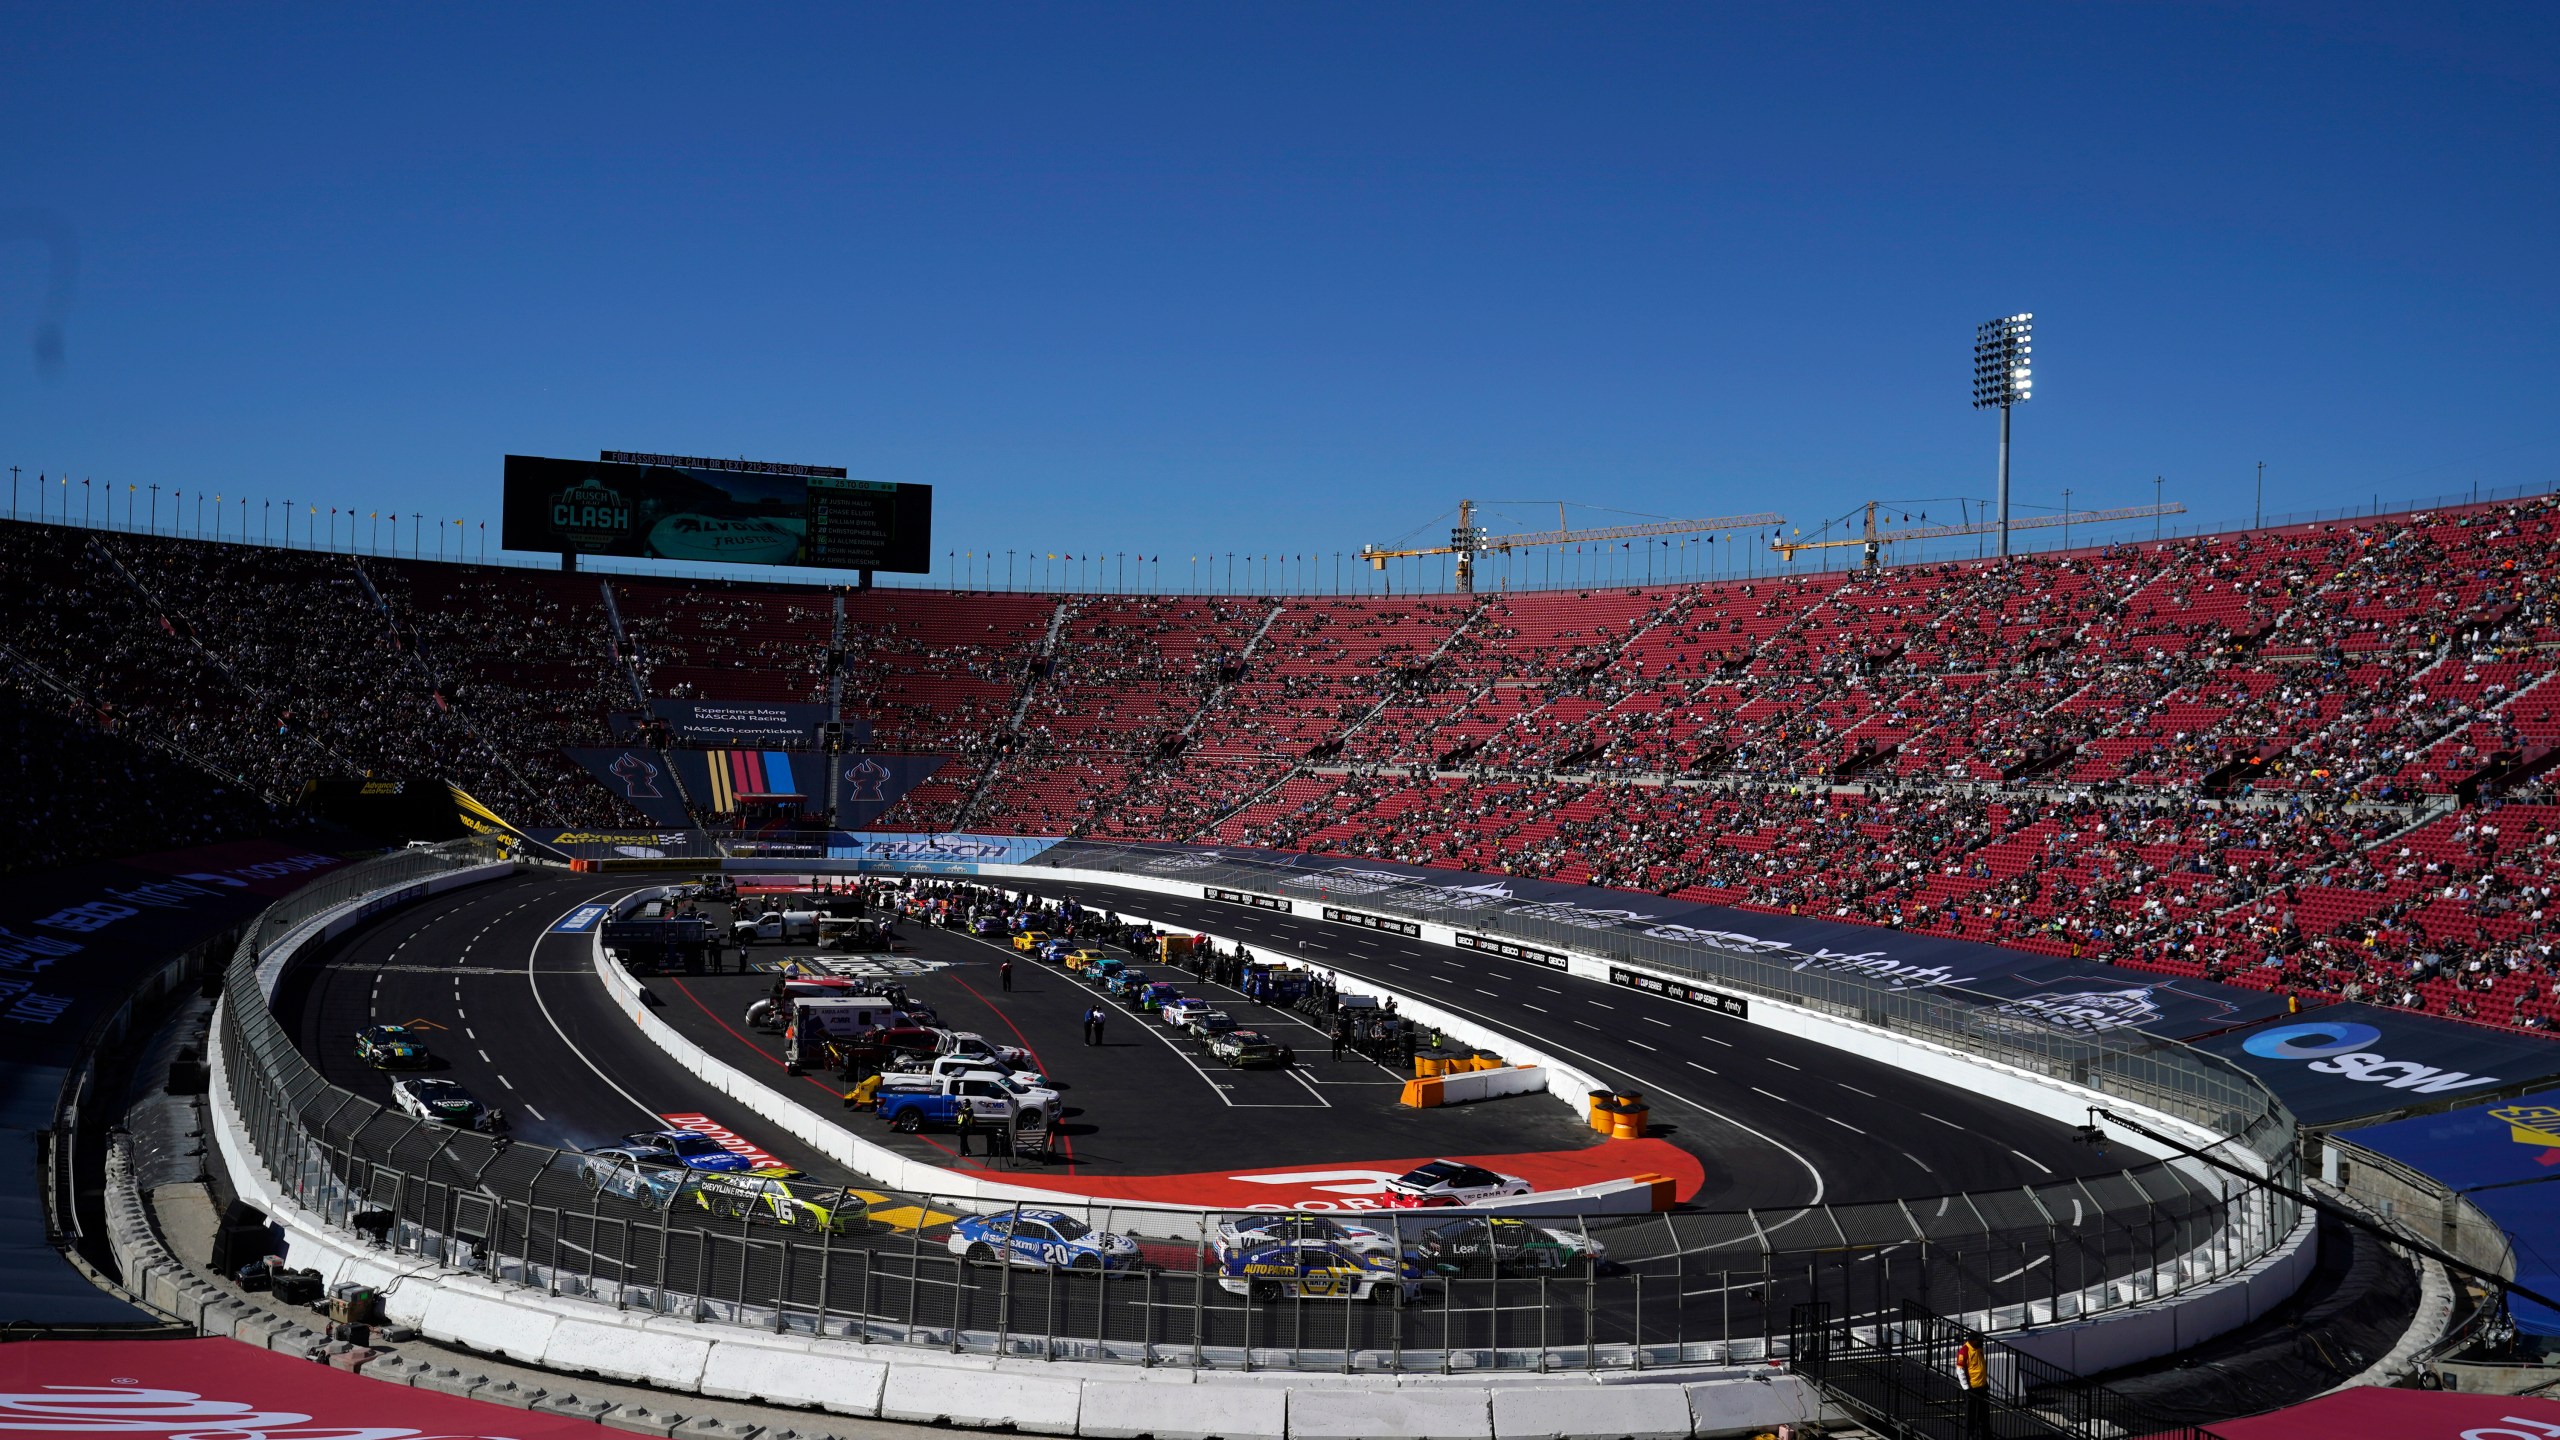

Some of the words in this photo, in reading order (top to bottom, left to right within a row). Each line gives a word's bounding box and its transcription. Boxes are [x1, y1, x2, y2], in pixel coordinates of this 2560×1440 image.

[612, 452, 629, 462] FOR
[631, 453, 685, 466] ASSISTANCE
[685, 458, 706, 468] CALL
[709, 460, 721, 469] OR
[724, 461, 744, 470] TEXT
[747, 462, 808, 475] 213-263-4007
[575, 490, 608, 501] BUSCH
[552, 503, 629, 529] CLASH
[713, 536, 777, 549] TRUSTED
[694, 706, 755, 716] Experience
[683, 725, 803, 735] NASCAR.com/tickets
[865, 842, 1009, 857] BUSCH
[1457, 936, 1474, 947] GEICO
[1487, 942, 1499, 952] SERIES
[1501, 945, 1519, 956] GEICO
[1533, 952, 1546, 962] SERIES
[1548, 956, 1566, 968] GEICO
[1783, 947, 1977, 991] xfinity
[1615, 971, 1630, 985] xfinity
[1640, 979, 1648, 988] CUP
[1648, 980, 1663, 991] SERIES
[1668, 984, 1684, 998] xfinity
[1694, 992, 1703, 1002] CUP
[1703, 993, 1719, 1006] SERIES
[1724, 999, 1742, 1014] xfinity
[668, 1116, 782, 1168] DOORDAS
[624, 1175, 636, 1194] 4
[1476, 1189, 1508, 1199] CAMRY
[772, 1198, 792, 1221] 16
[1042, 1243, 1069, 1266] 20
[1243, 1263, 1268, 1274] AUTO
[1268, 1265, 1295, 1276] PARTS
